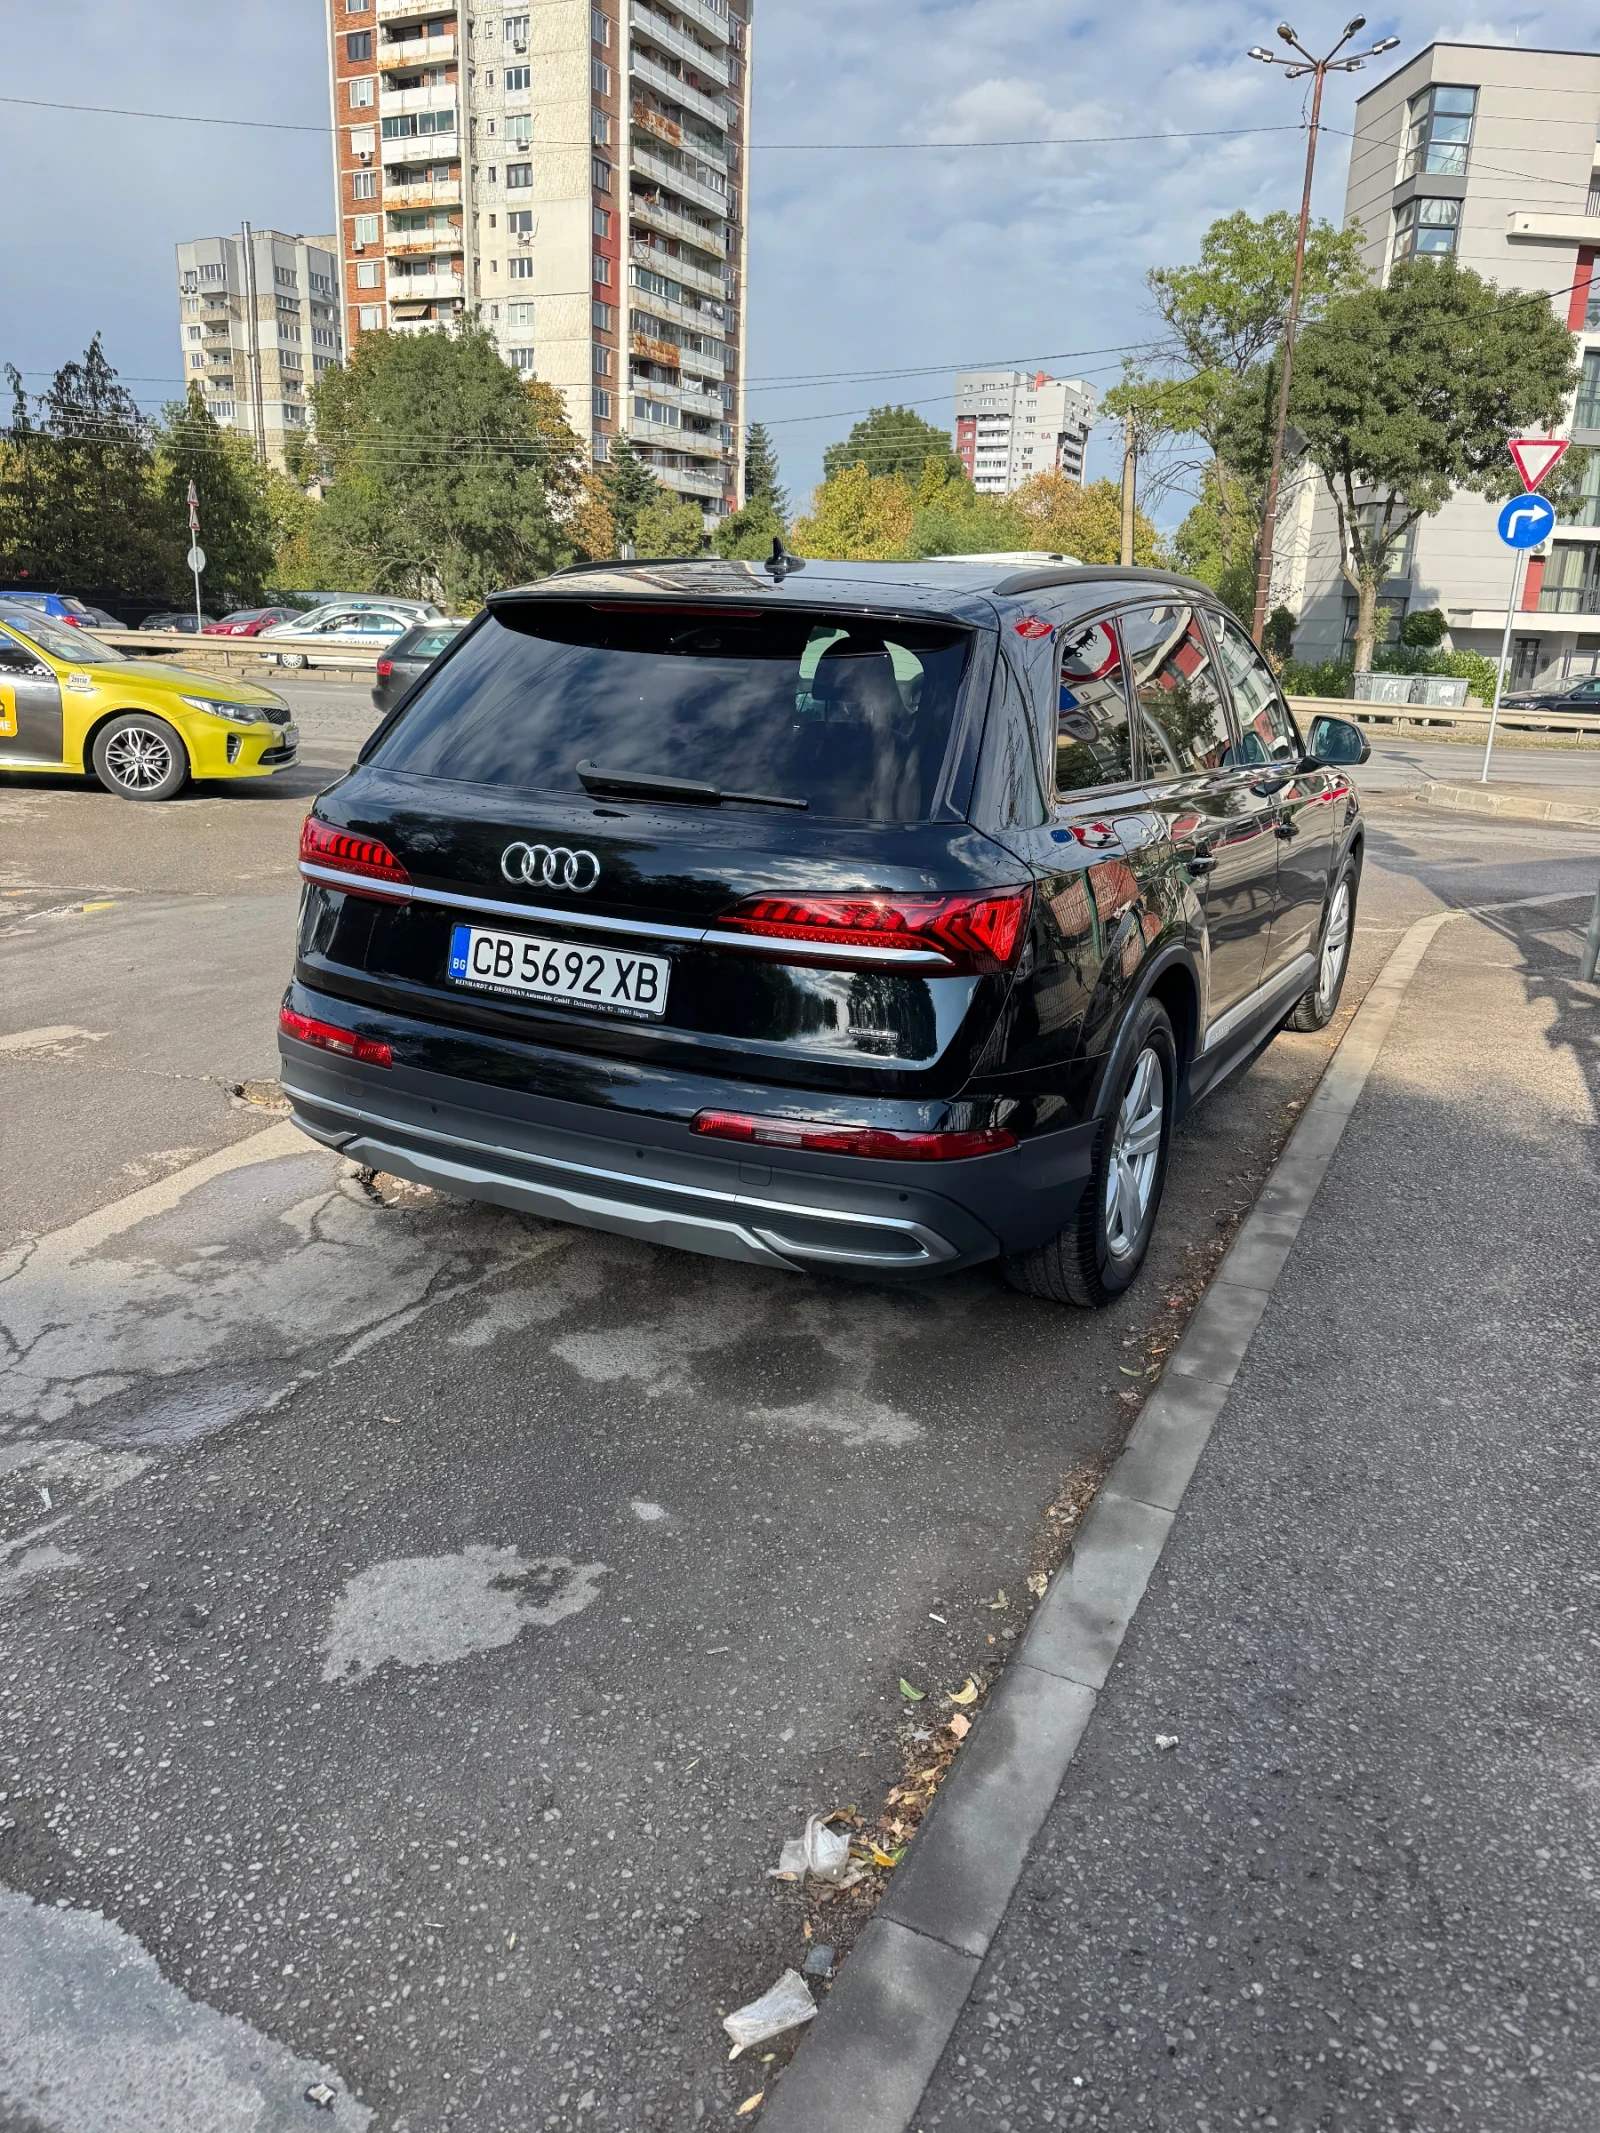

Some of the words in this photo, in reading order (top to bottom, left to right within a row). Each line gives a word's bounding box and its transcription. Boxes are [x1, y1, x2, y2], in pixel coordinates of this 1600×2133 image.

[452, 957, 466, 971] BG
[473, 937, 514, 978] CB
[520, 943, 605, 995] 5692
[611, 958, 658, 1004] XB
[455, 979, 487, 990] REINHARDT
[525, 992, 553, 1002] Automobile
[553, 997, 570, 1005] GmbH
